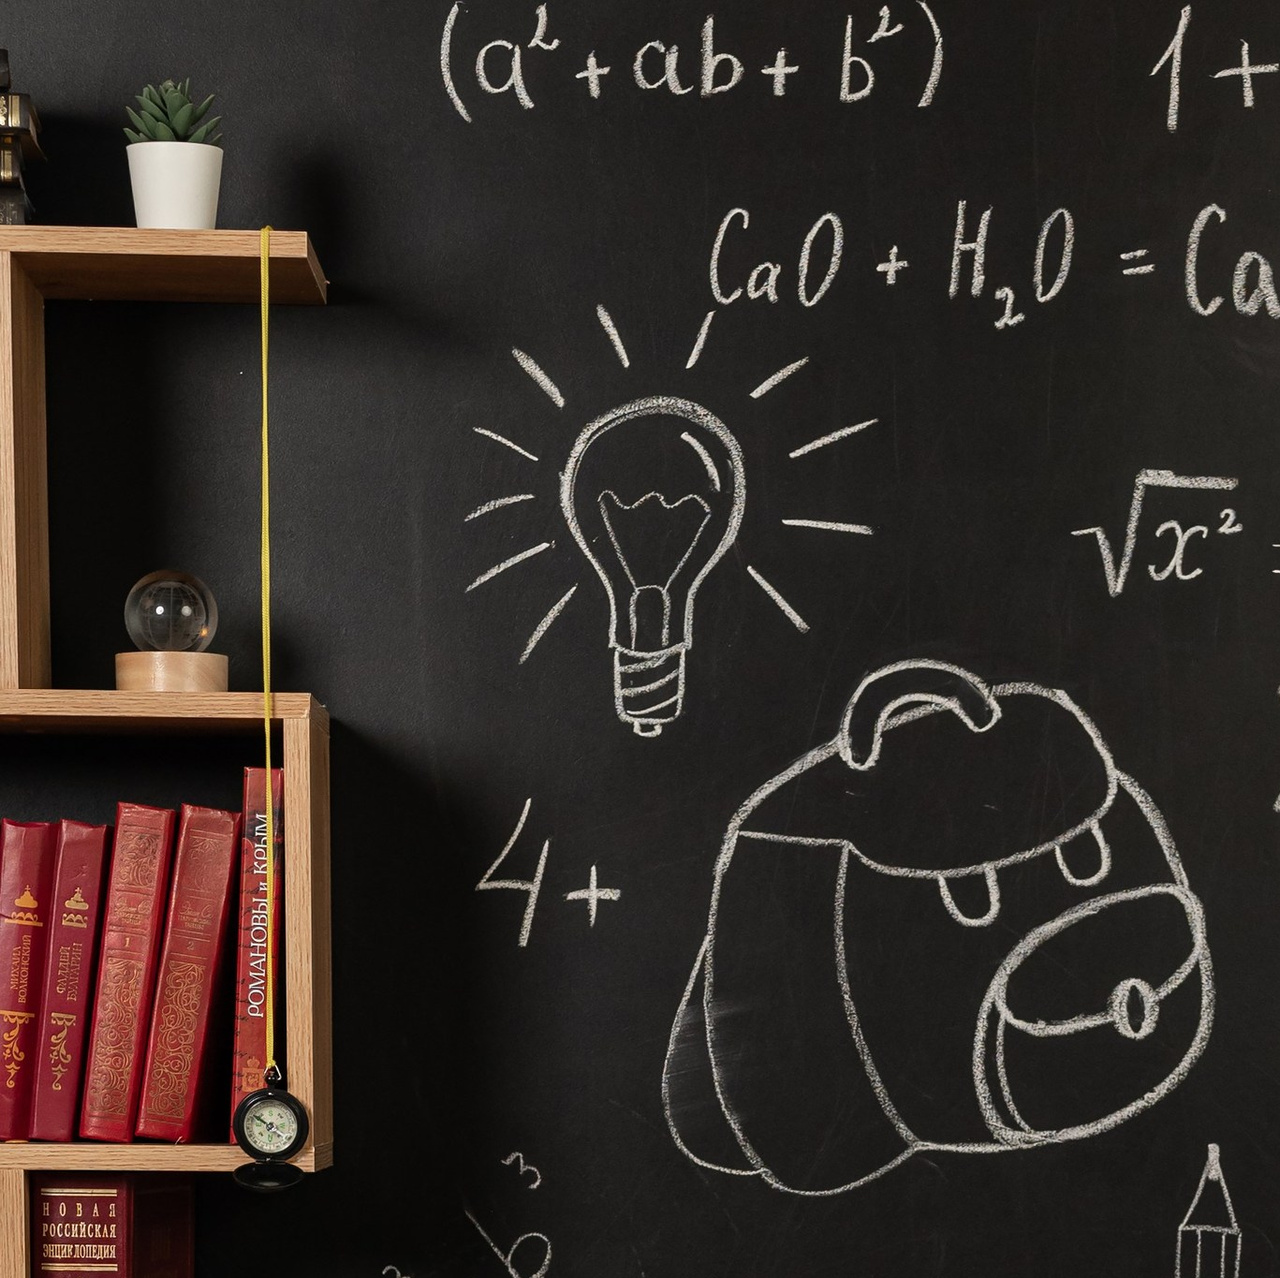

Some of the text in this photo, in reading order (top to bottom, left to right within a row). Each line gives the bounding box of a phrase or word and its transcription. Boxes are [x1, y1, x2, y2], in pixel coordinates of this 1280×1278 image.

[17, 934, 32, 1004] ВОЛКОНСКИЙ
[56, 946, 71, 994] ФАДДЕЙ
[66, 942, 83, 1002] БУЛГАРИН
[247, 898, 270, 1018] РОМАНОВЫ
[42, 1202, 117, 1218] НОВАЯ
[42, 1221, 117, 1238] РОССИЙСКАЯ
[42, 1243, 117, 1260] ЭНЦИКЛОПЕДИЯ
